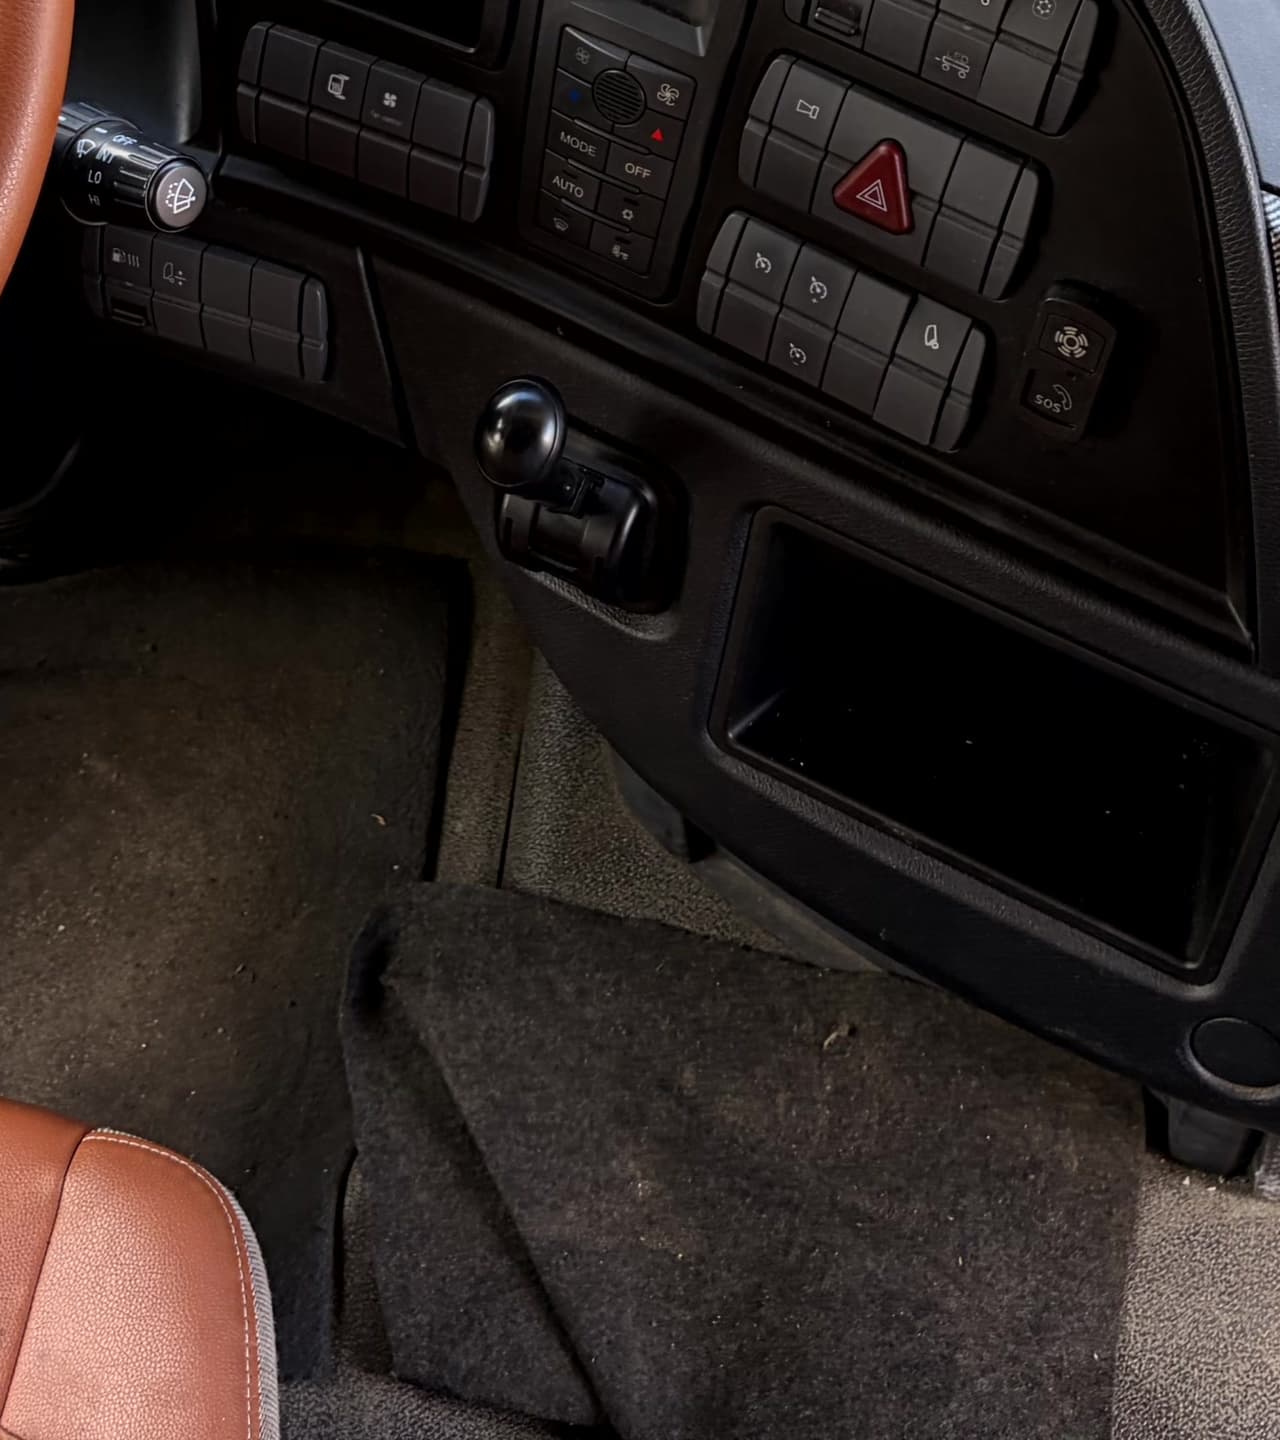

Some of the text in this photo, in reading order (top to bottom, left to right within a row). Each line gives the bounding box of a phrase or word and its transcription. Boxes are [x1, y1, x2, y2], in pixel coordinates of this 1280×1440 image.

[560, 131, 598, 157] MODE
[87, 169, 102, 184] LO
[624, 162, 652, 179] OFF
[552, 175, 585, 199] AUTO
[1034, 394, 1062, 413] SOS
